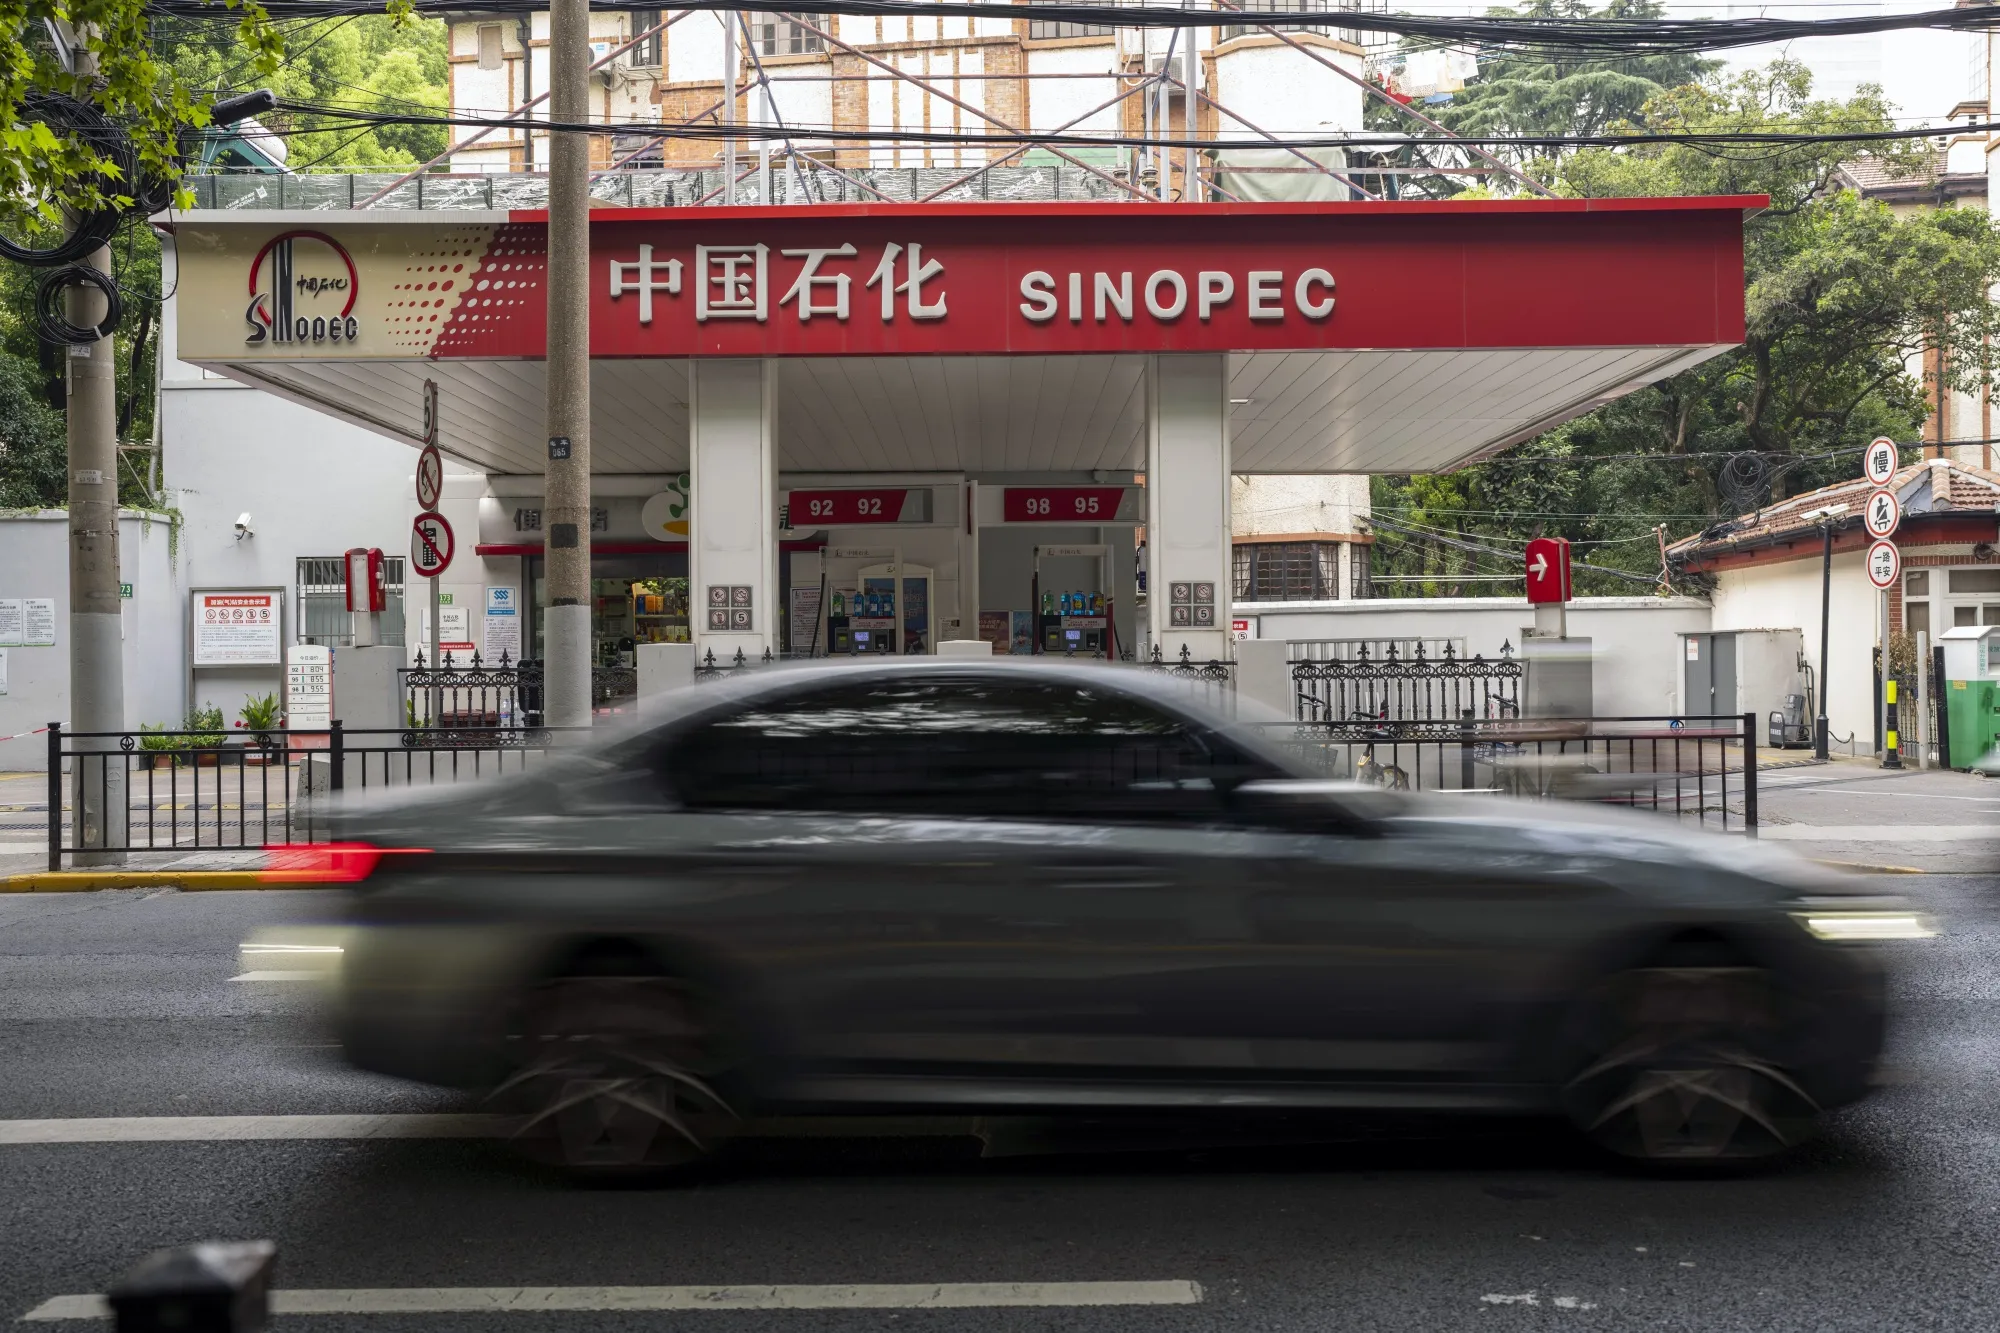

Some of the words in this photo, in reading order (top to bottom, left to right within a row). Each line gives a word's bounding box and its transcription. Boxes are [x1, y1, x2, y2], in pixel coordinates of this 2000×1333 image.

[610, 242, 948, 323] 中国石化
[1020, 268, 1336, 321] SINOPEC
[552, 447, 566, 457] 065
[1873, 450, 1889, 475] 慢
[809, 499, 834, 516] 92
[857, 498, 882, 515] 92
[1026, 498, 1051, 514] 98
[1074, 497, 1099, 514] 95
[1875, 551, 1891, 563] 一路
[1875, 566, 1891, 577] 平安
[262, 610, 268, 618] 5
[738, 613, 745, 622] 5
[1200, 609, 1207, 618] 5
